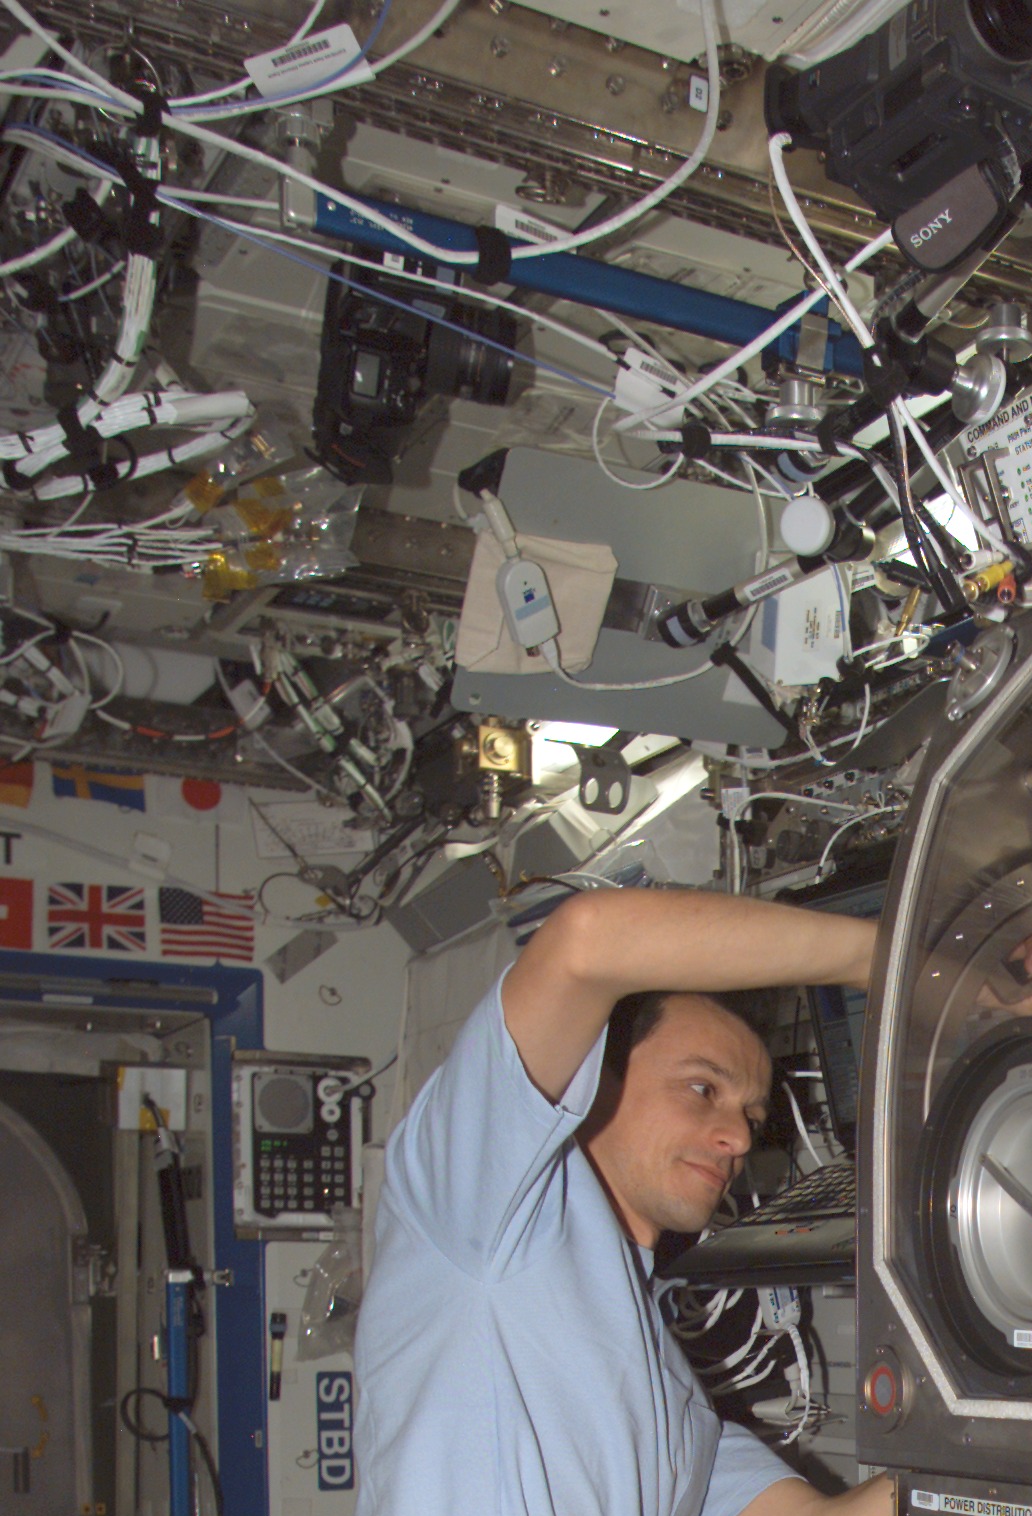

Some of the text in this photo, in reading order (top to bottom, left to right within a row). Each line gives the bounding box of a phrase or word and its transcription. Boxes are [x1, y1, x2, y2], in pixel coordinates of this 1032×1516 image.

[910, 209, 953, 249] SONY
[967, 414, 1010, 442] COMMAND
[1011, 400, 1029, 417] AND
[319, 1377, 351, 1485] STBD
[944, 1496, 975, 1513] POWER
